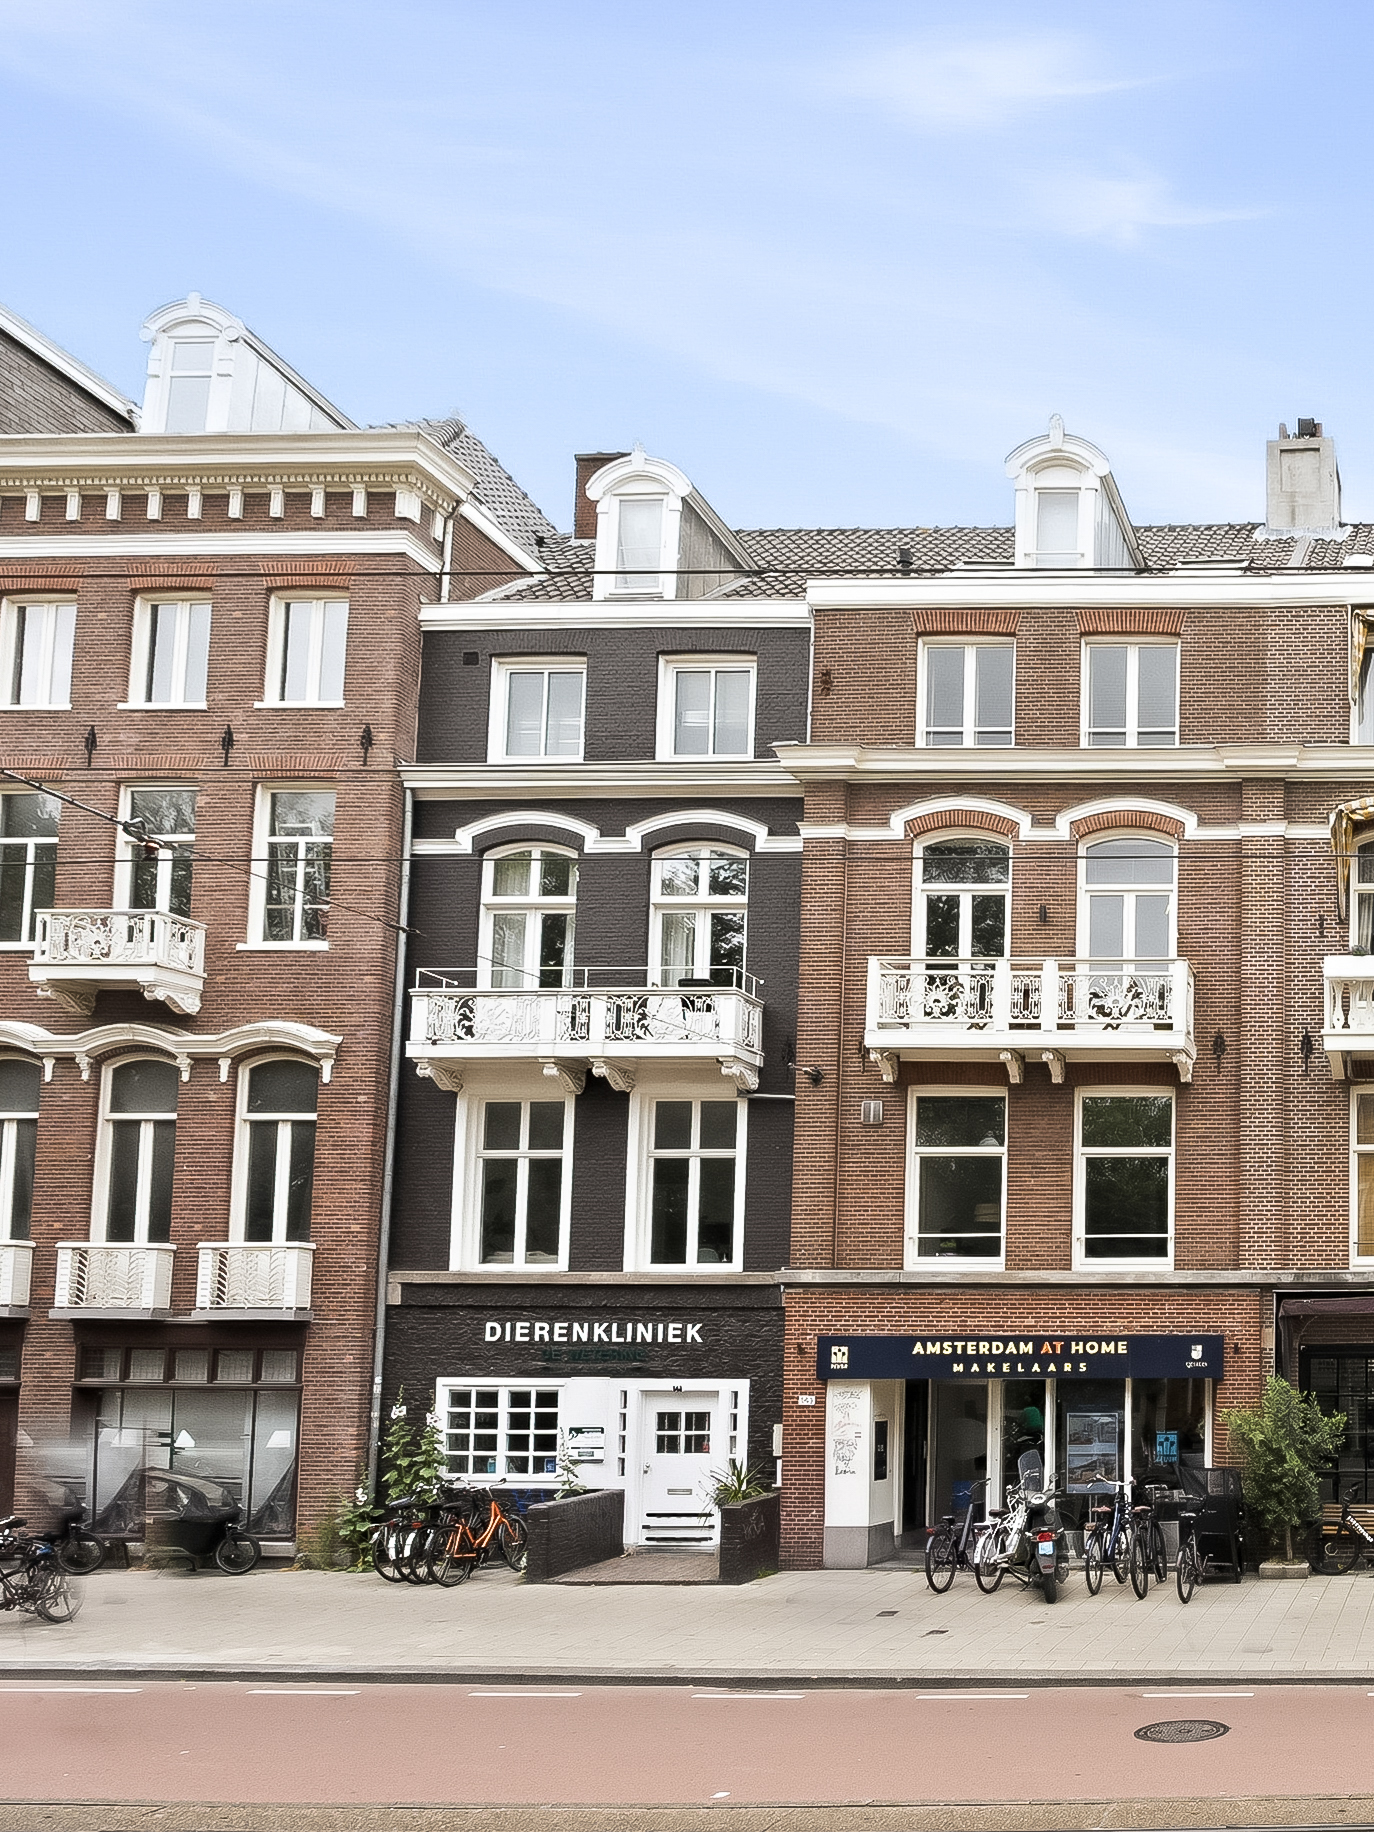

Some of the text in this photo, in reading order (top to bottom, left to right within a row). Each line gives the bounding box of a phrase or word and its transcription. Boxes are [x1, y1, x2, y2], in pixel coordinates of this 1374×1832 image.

[484, 1321, 704, 1343] DIERENKLINIEK
[911, 1341, 1129, 1355] AMSTERDAM AT HOME
[952, 1362, 1087, 1373] MAKELAARS
